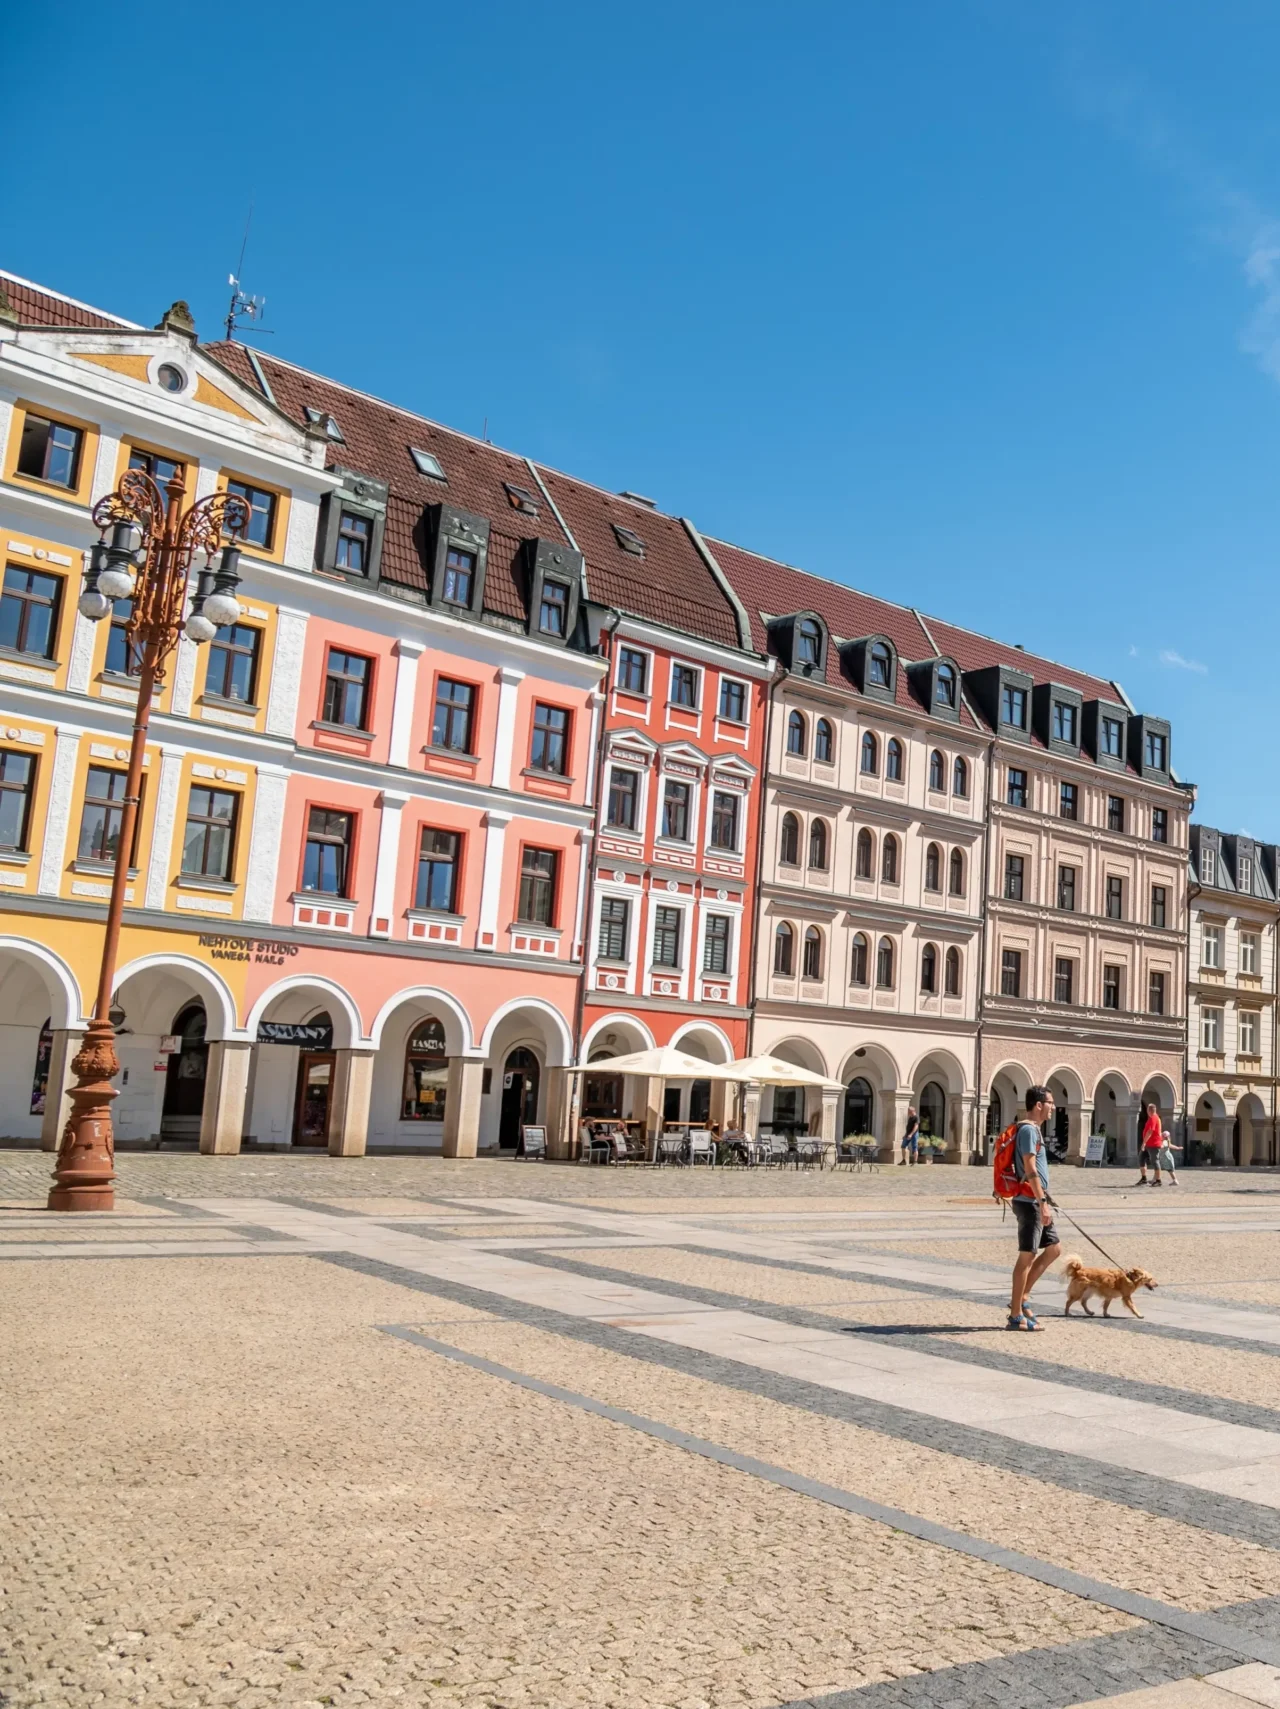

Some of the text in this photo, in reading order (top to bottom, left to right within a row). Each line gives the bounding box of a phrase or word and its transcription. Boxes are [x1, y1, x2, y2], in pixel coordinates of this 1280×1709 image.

[257, 942, 299, 956] STUDIO
[211, 950, 284, 965] VANESA NAILS
[258, 1023, 331, 1040] ASMANY
[412, 1039, 445, 1050] TASMA
